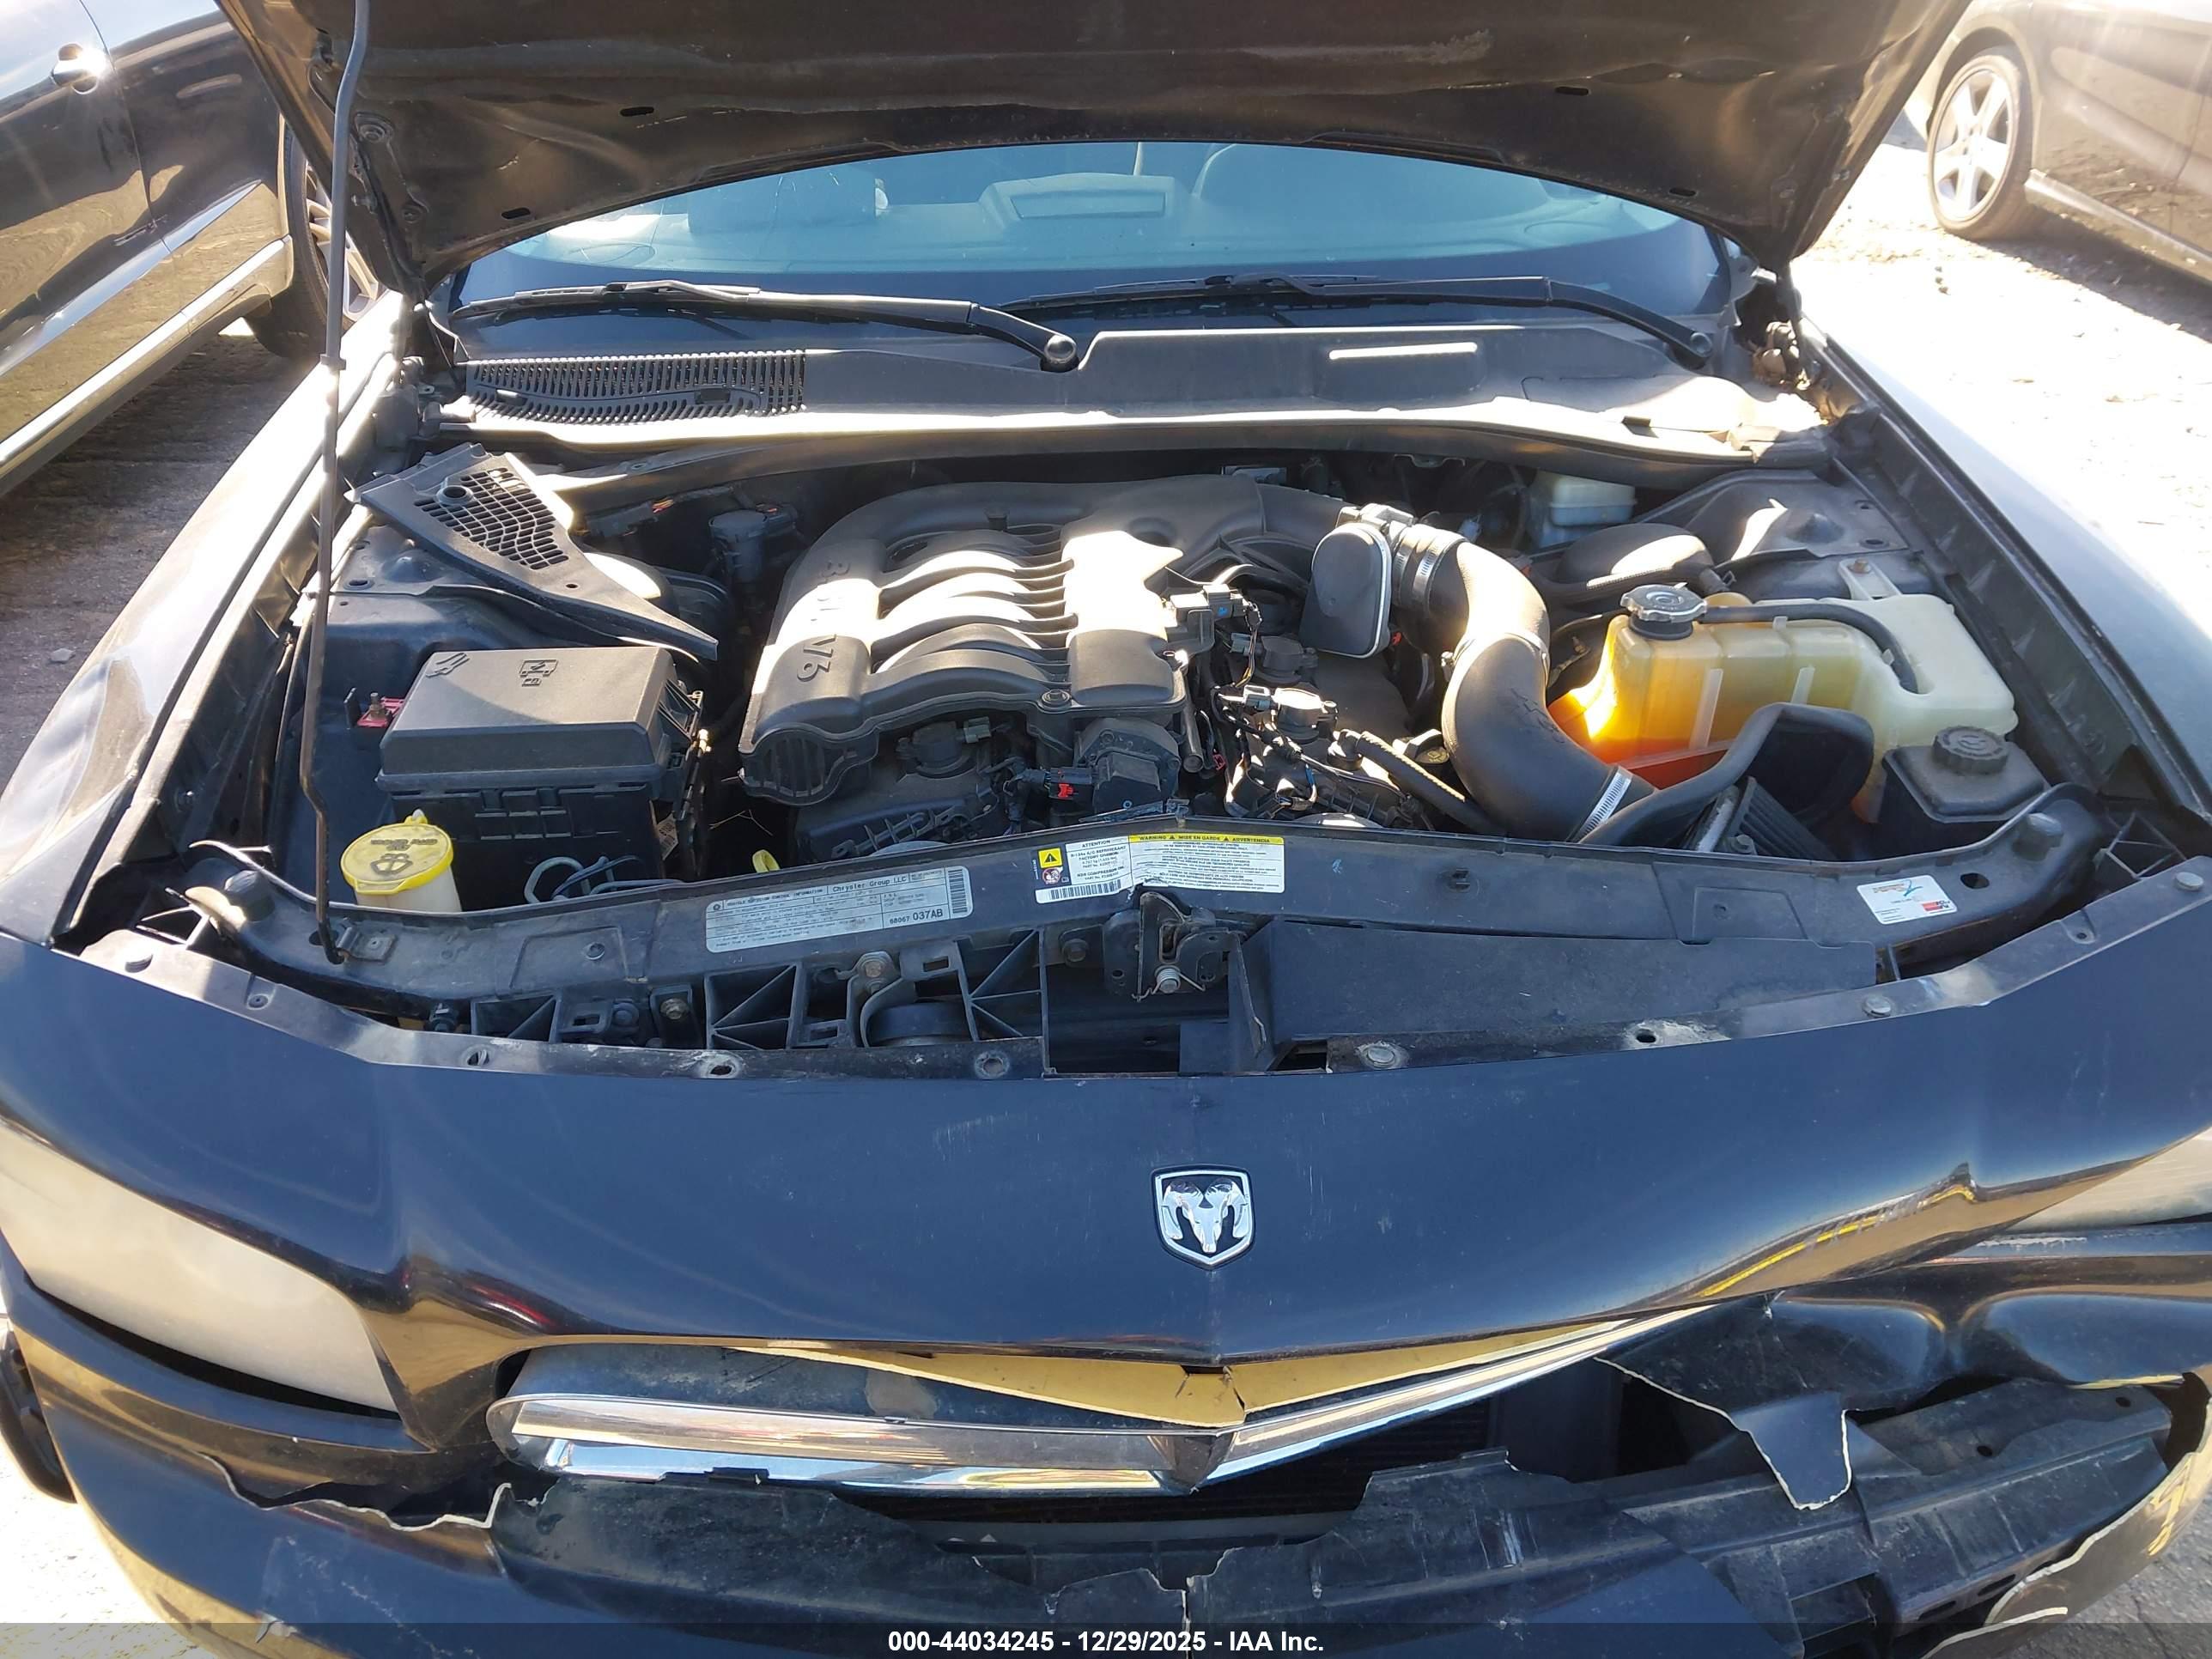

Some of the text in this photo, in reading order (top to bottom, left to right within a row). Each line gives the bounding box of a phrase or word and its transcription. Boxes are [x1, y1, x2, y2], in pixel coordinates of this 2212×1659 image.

[796, 634, 838, 683] V6
[832, 882, 866, 893] Chrysler
[869, 878, 890, 889] Group
[893, 876, 907, 884] LLC
[889, 908, 944, 925] 68067 037AB
